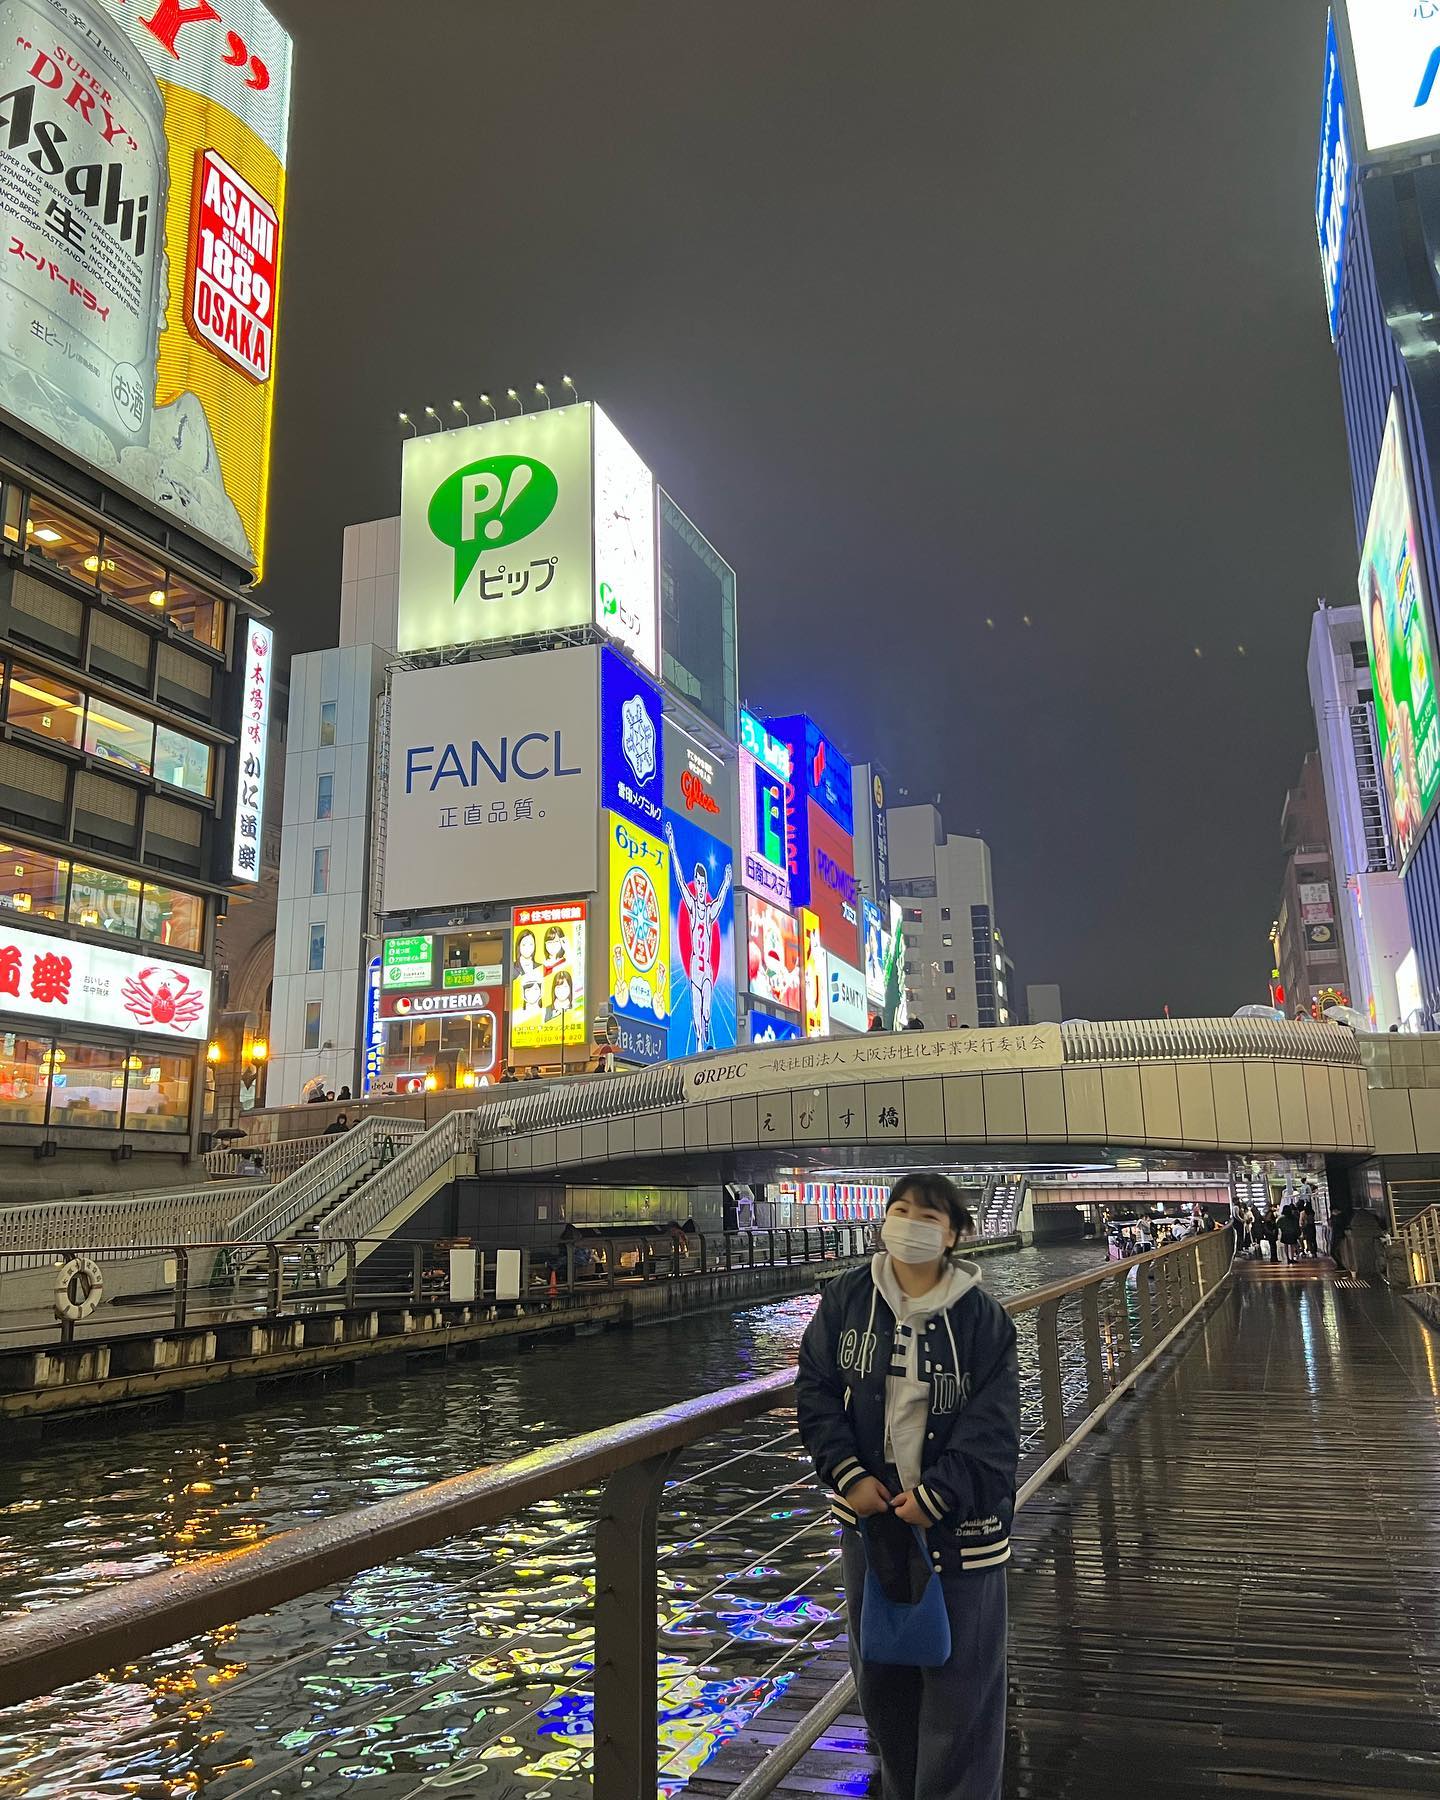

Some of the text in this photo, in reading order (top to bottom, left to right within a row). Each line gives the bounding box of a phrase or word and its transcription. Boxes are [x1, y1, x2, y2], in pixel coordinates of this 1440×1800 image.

[54, 46, 112, 108] SUPER
[0, 84, 149, 257] Asahi
[6, 179, 41, 207] JAPANESE
[90, 244, 117, 271] MASTER
[20, 214, 41, 231] CRISP
[41, 229, 63, 249] TASTE
[64, 247, 81, 263] AND
[21, 164, 35, 177] DRY
[36, 175, 43, 184] IS
[44, 181, 74, 207] BREWED
[75, 204, 92, 223] WITH
[94, 222, 125, 253] PRECISION
[125, 252, 131, 261] TO
[45, 197, 87, 256] 生
[204, 166, 274, 265] ASAHI
[91, 231, 114, 256] UNDER
[222, 228, 255, 268] since
[8, 235, 110, 323] スーパードライ
[201, 227, 271, 320] 1889
[30, 319, 76, 359] 生ビール
[197, 279, 266, 374] OSAKA
[479, 555, 559, 601] ピップ
[247, 661, 265, 745] 本場の味
[405, 730, 582, 794] FANCL
[438, 797, 546, 829] 正直品質。
[413, 993, 483, 1011] LOTTERIA
[841, 983, 865, 1010] SAMTY
[759, 1050, 846, 1073] 一般社団法人
[852, 1034, 1046, 1063] 大阪活性化事業実行委員会
[762, 1106, 899, 1132] えびす橋
